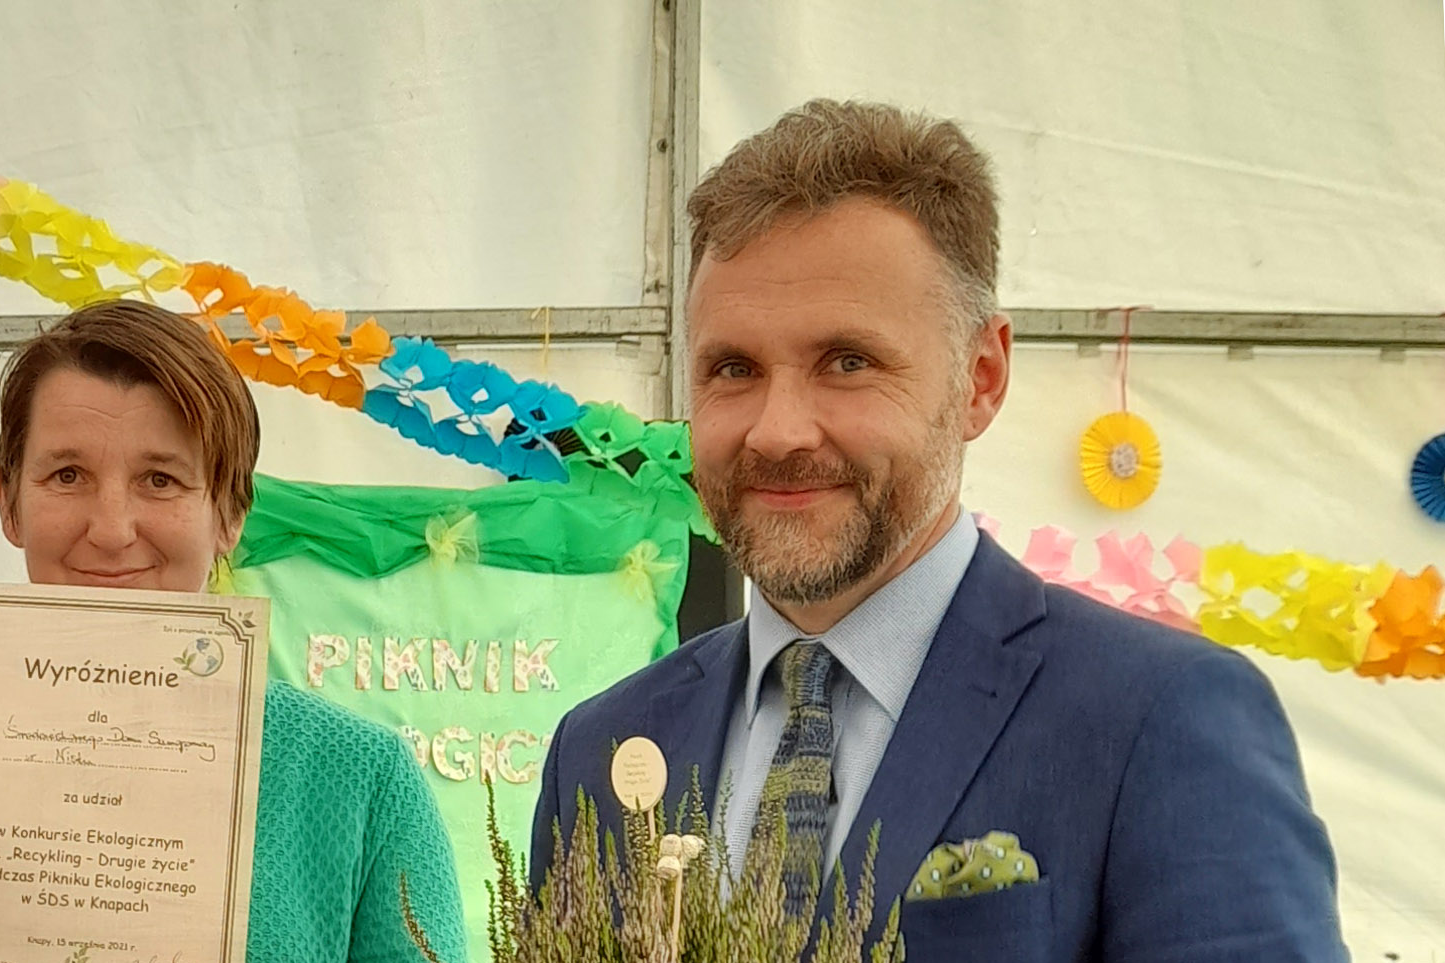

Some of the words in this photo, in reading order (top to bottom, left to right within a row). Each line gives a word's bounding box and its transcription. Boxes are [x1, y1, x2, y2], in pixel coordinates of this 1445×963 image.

[24, 657, 179, 688] Wyróżnienie
[307, 633, 560, 693] PIKNIK
[88, 711, 108, 723] dla
[63, 793, 78, 804] za
[82, 793, 123, 806] udział
[11, 826, 82, 843] Konkursie
[86, 830, 184, 850] Ekologicznym
[99, 852, 146, 871] Drugie
[39, 870, 90, 887] Pikniku
[95, 875, 197, 897] Ekologicznego
[21, 893, 32, 904] w
[37, 888, 69, 907] ŚDS
[74, 897, 85, 908] w
[90, 896, 149, 913] Knapach
[57, 938, 67, 946] 15
[108, 941, 128, 951] 2021
